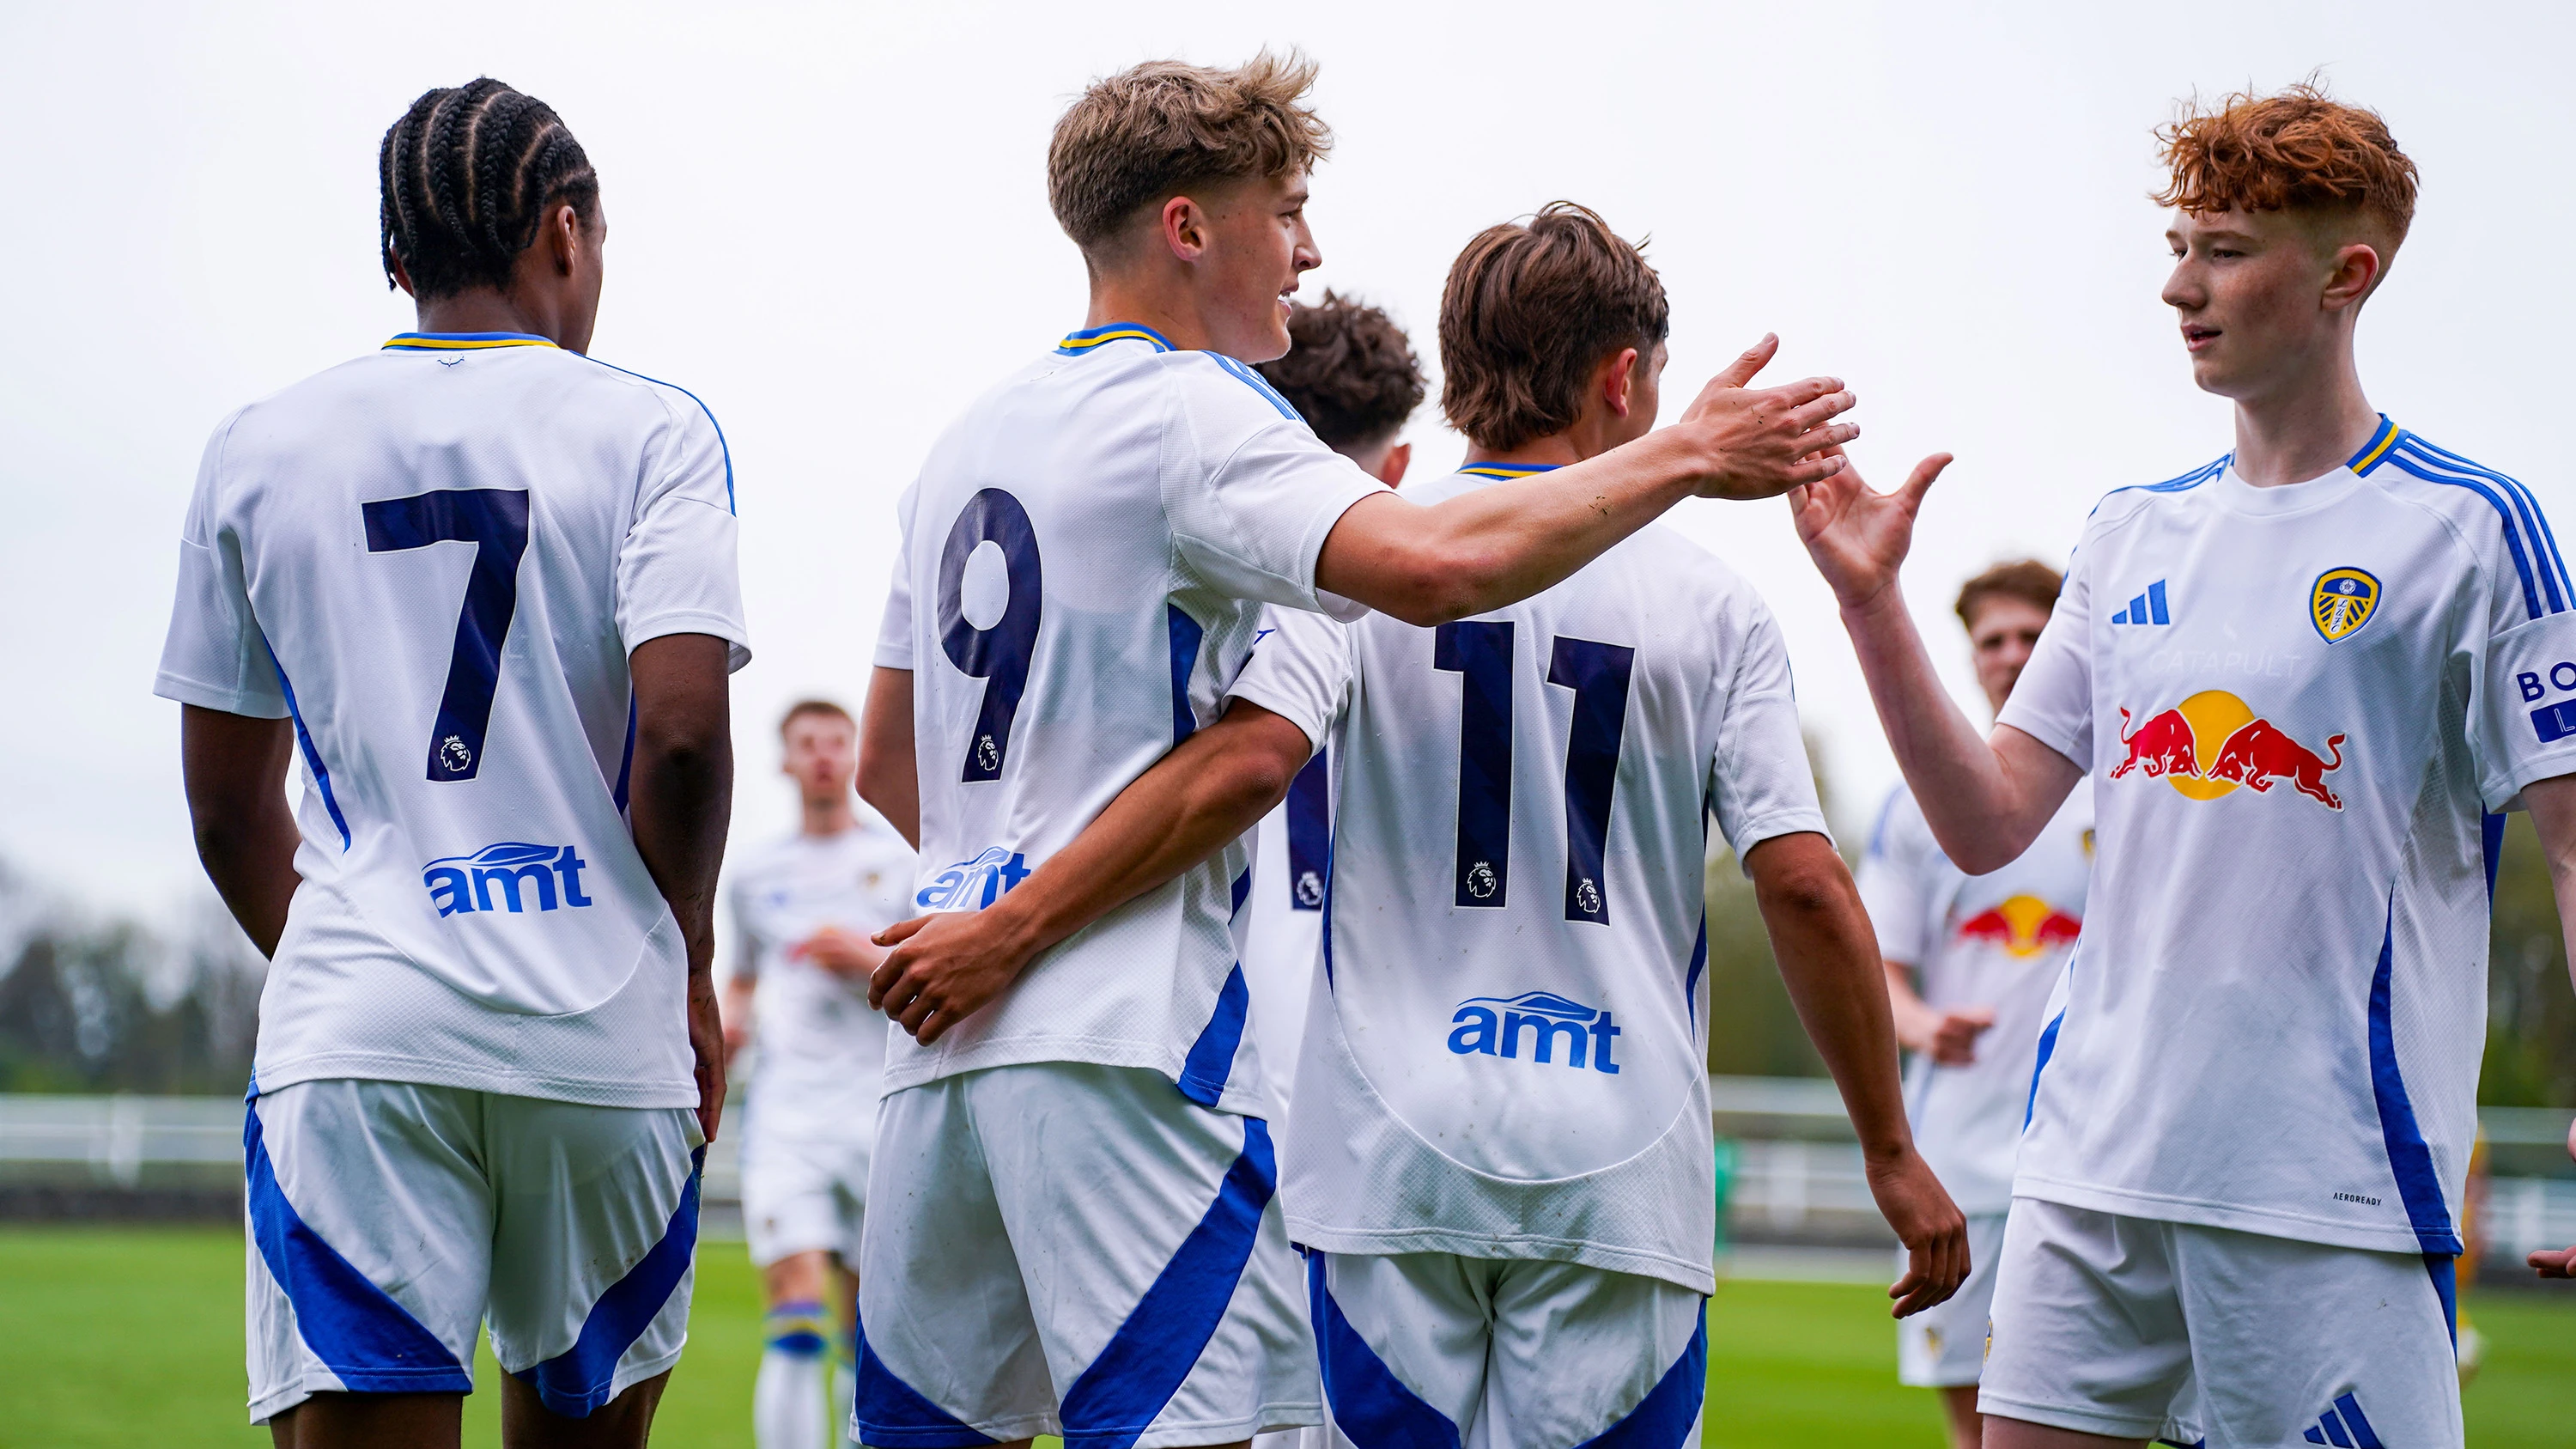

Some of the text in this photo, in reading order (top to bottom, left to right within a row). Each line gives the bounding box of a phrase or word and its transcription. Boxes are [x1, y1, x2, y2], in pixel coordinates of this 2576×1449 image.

[361, 488, 530, 782] 7
[937, 487, 1042, 783] 9
[2149, 650, 2302, 678] CATAPULT
[1434, 620, 1635, 927] 11
[423, 843, 592, 918] amt
[1444, 995, 1621, 1075] amt
[2332, 1192, 2382, 1207] AEROREADY
